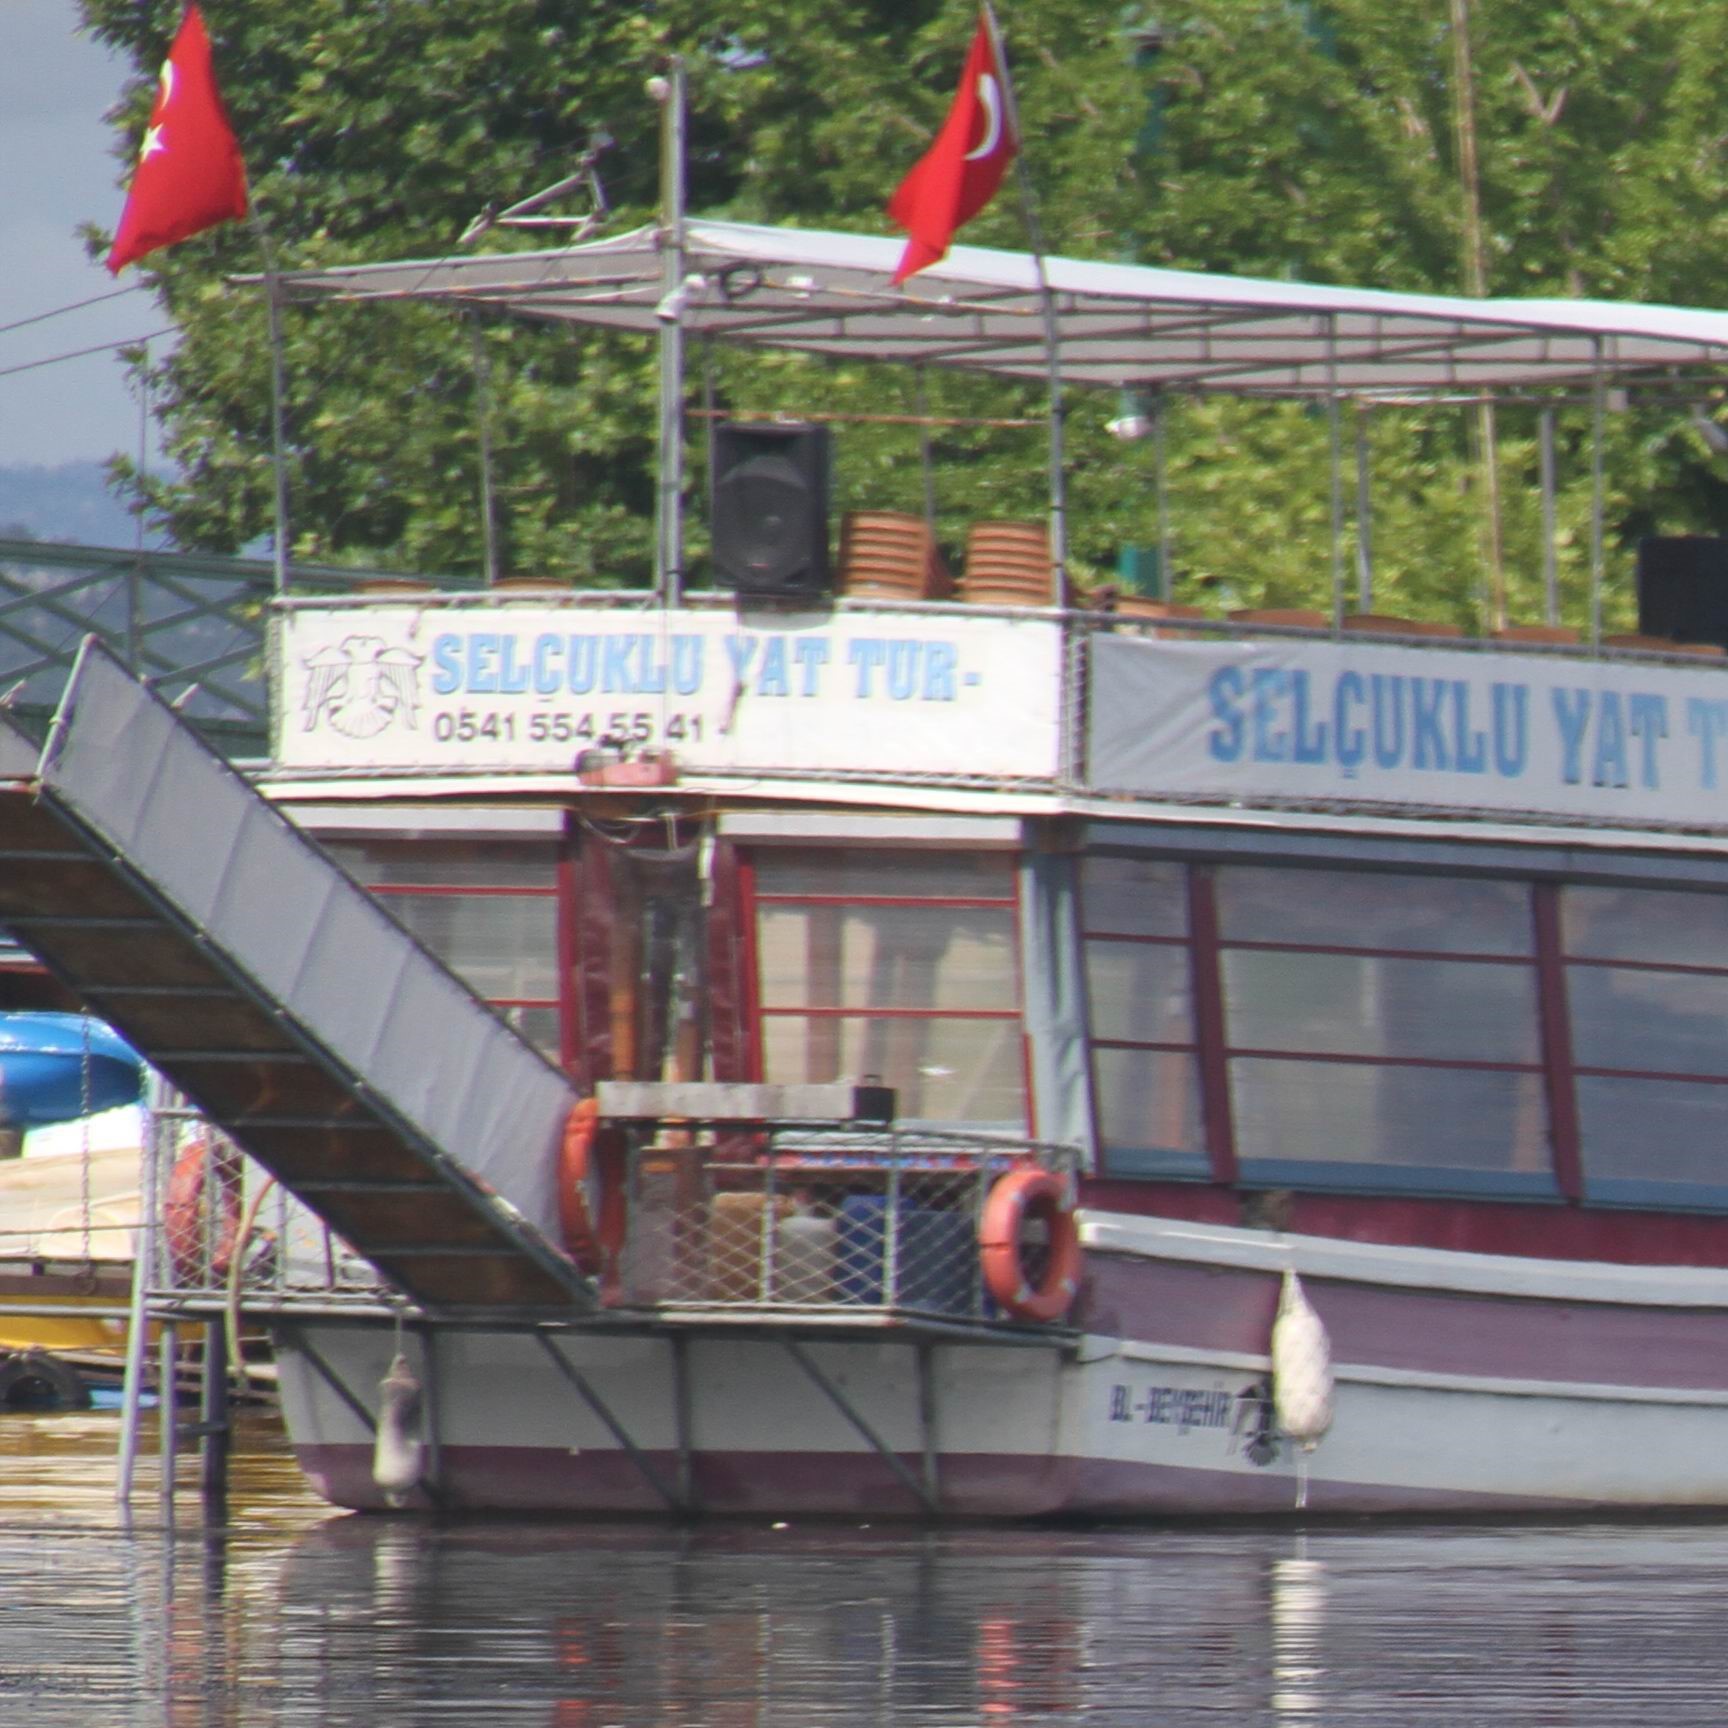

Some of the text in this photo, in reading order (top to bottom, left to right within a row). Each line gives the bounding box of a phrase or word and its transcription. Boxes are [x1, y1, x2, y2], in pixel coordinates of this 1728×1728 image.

[432, 633, 705, 702] SELÇUKLU
[723, 633, 830, 698] YAT
[433, 711, 705, 743] 0541 554 55 41
[1208, 665, 1529, 779] SELÇUKLU
[1551, 686, 1669, 791] YAT
